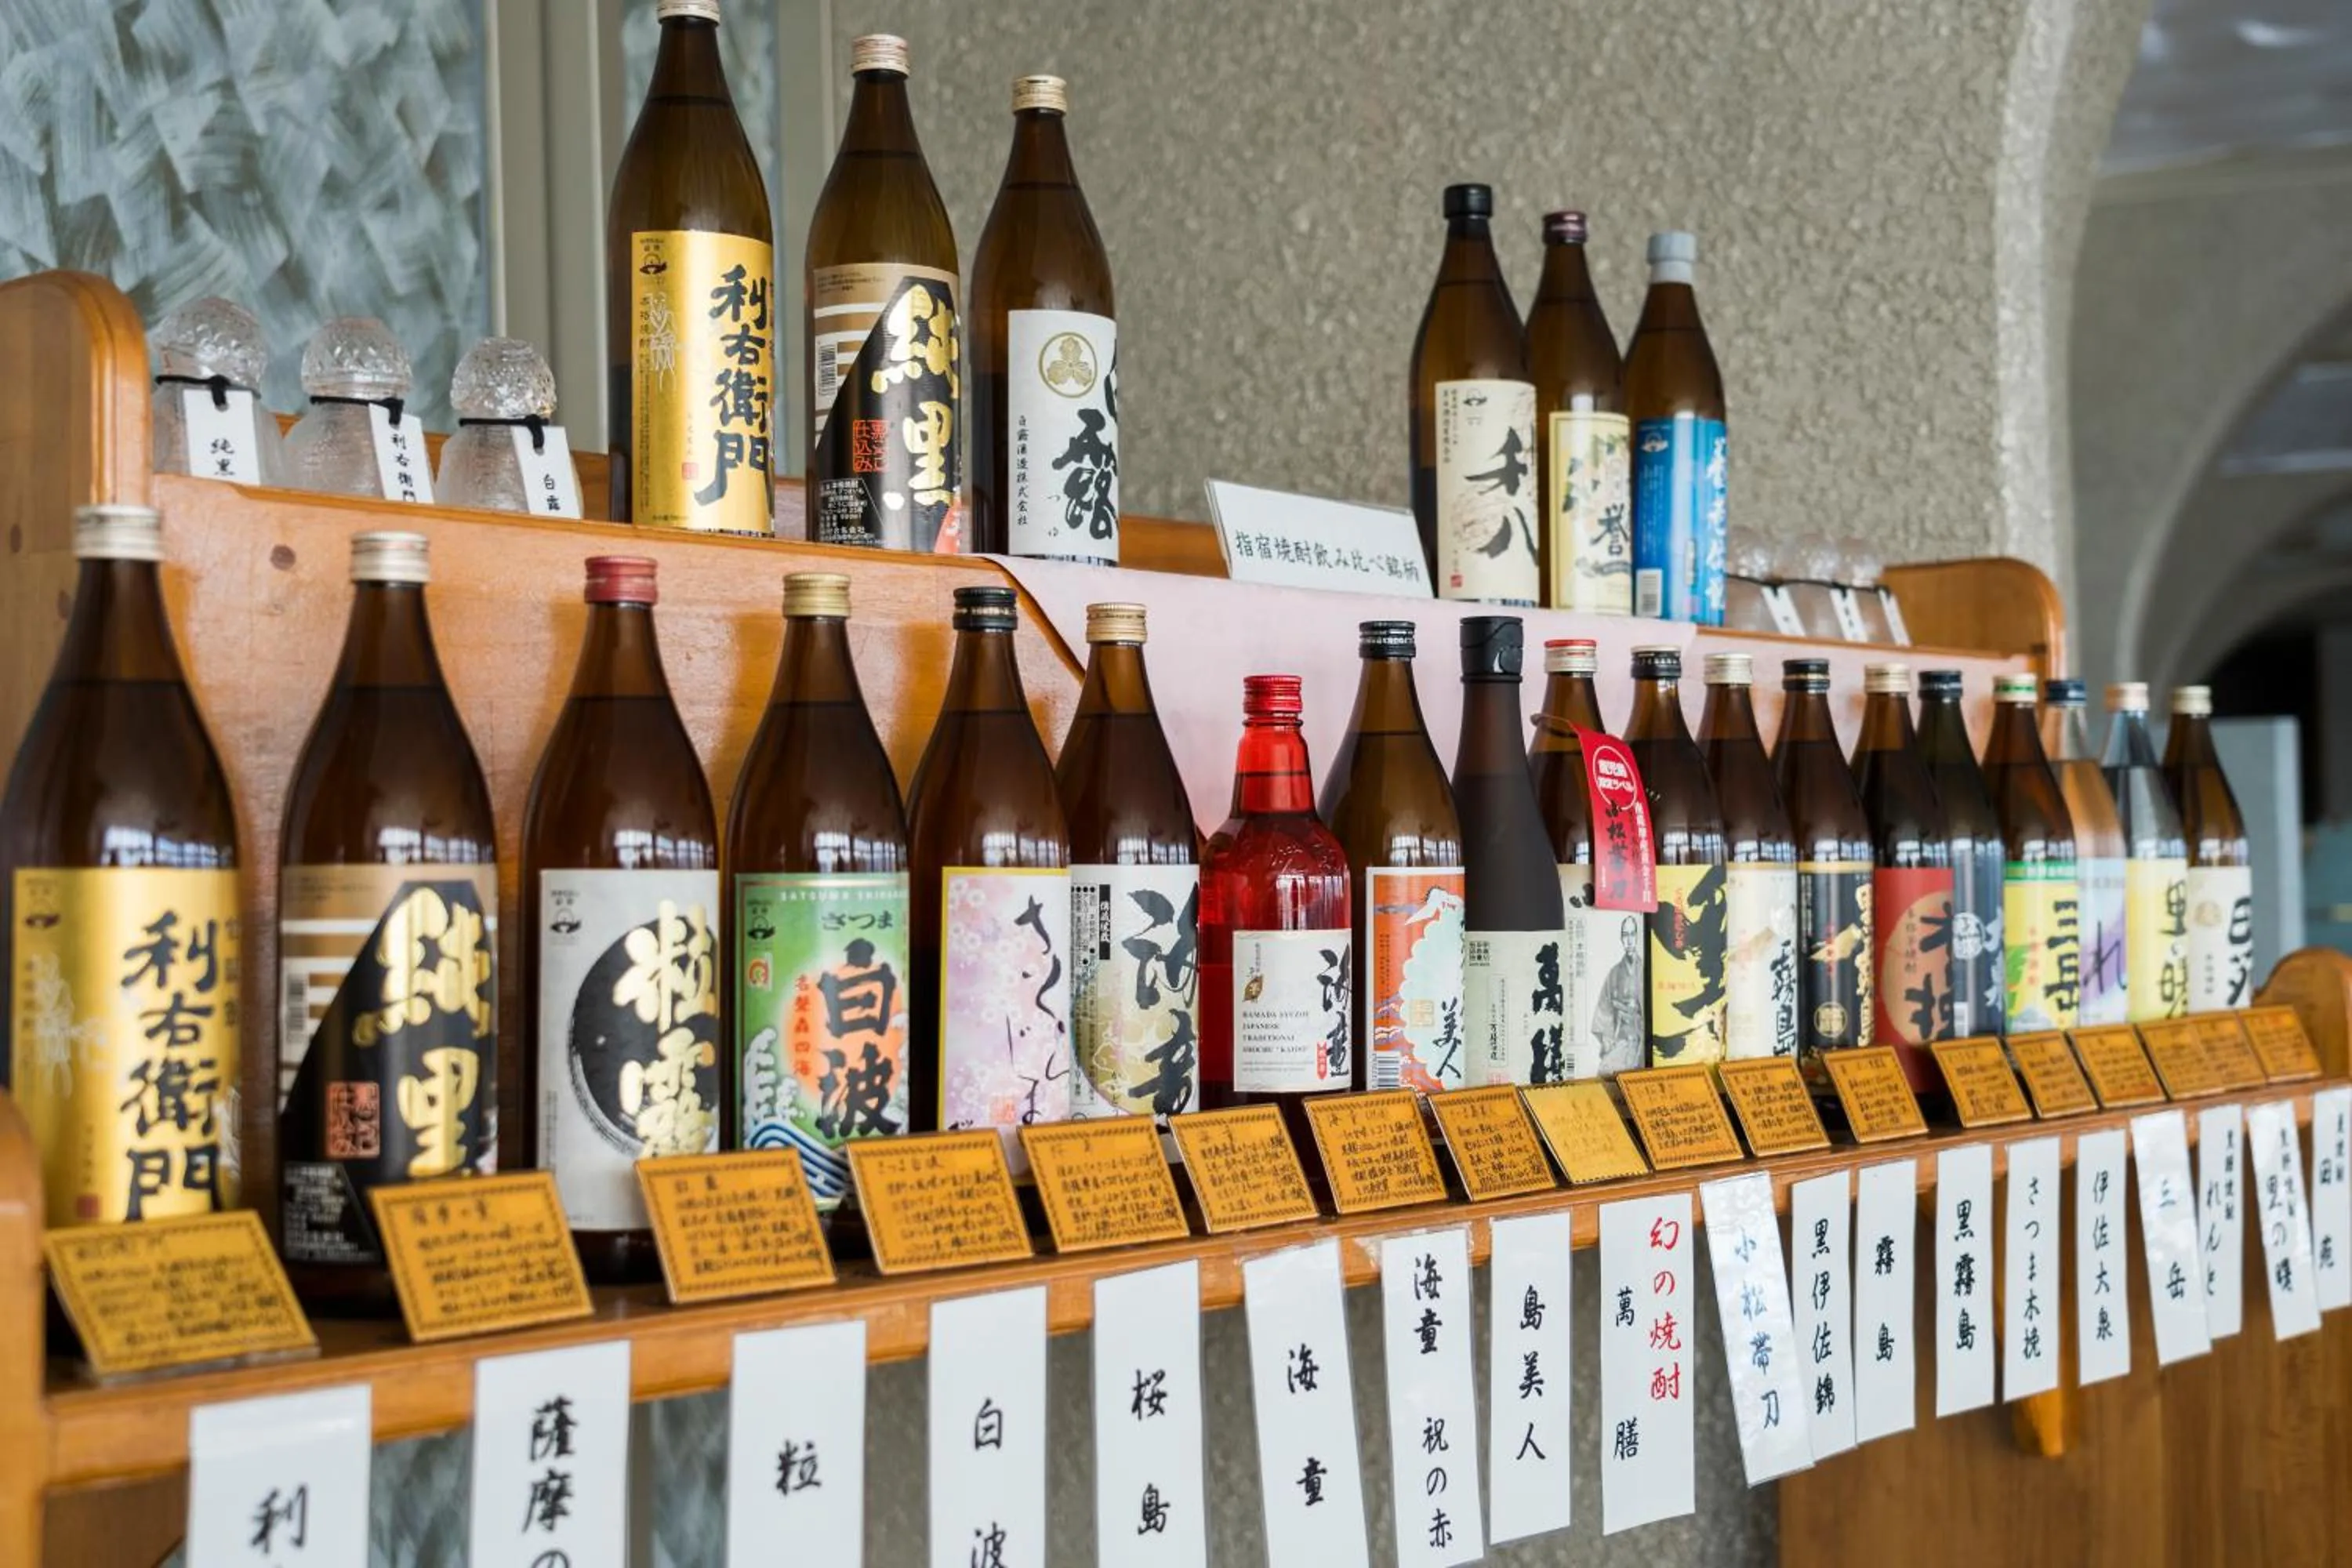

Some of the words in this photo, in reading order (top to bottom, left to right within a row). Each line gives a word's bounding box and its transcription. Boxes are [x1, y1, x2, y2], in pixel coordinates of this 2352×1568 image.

[694, 263, 775, 517] 利右衛門
[821, 909, 893, 931] さつま
[119, 909, 223, 1222] 利右衛門
[815, 938, 903, 1141] 白波
[1413, 1252, 1443, 1356] 海童
[1648, 1216, 1682, 1402] 幻の焼酎
[1811, 1218, 1836, 1415] 黒伊佐錦
[1874, 1234, 1895, 1363] 霧島
[1954, 1198, 1976, 1351] 黒霧島
[2023, 1176, 2042, 1360] さつま木挽
[2092, 1169, 2114, 1342] 伊佐大泉
[2158, 1178, 2187, 1300] 三岳
[2205, 1179, 2222, 1297] れんと
[1515, 1284, 1547, 1461] 島美人
[1613, 1285, 1640, 1461] 萬膳
[1733, 1226, 1780, 1431] 小松帯刀
[774, 1438, 823, 1497] 粒
[970, 1397, 1010, 1568] 白波
[1130, 1368, 1172, 1537] 桜島
[1286, 1341, 1329, 1508] 海童
[1421, 1415, 1454, 1549] 祝の赤
